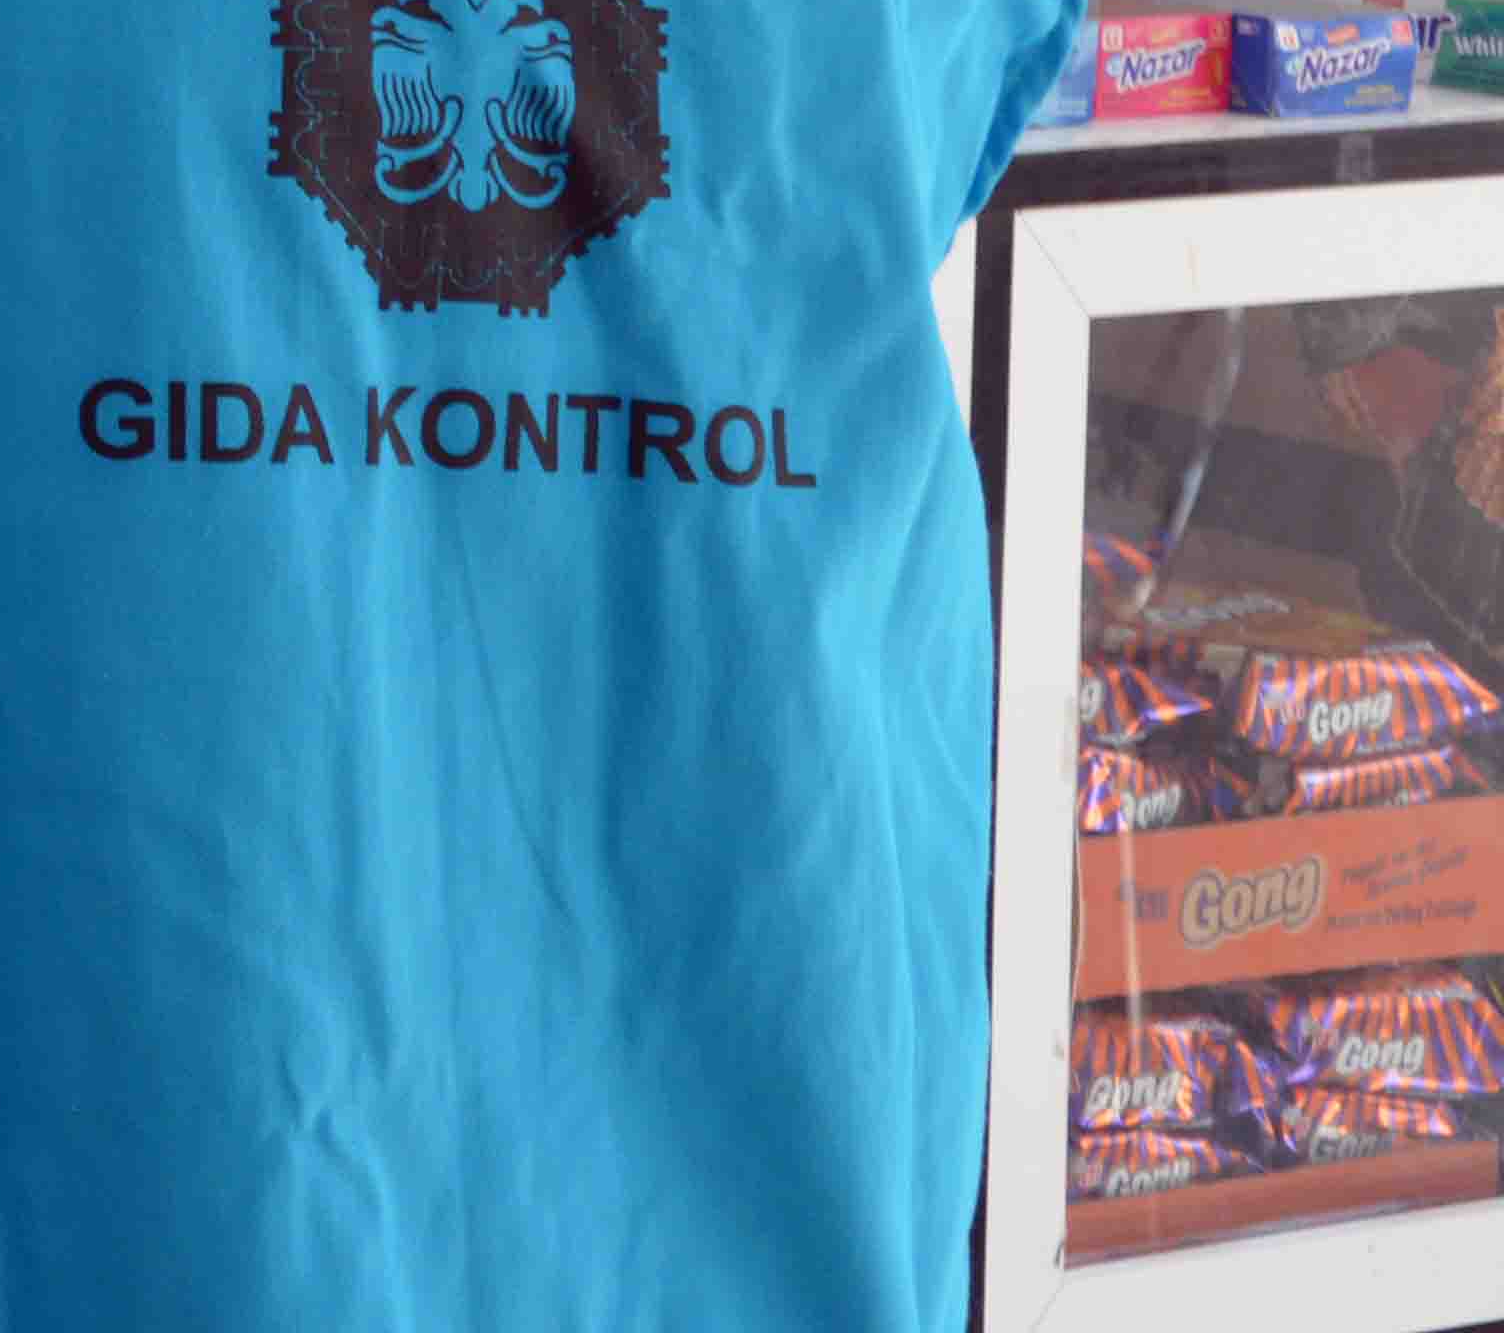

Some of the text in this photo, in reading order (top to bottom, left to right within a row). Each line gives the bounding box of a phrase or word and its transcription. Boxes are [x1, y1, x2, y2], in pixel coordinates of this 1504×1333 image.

[1118, 37, 1206, 93] Nazar
[1296, 37, 1390, 91] Nazar
[78, 376, 818, 489] GIDA KONTROL
[1308, 689, 1393, 745] Gong
[1183, 854, 1327, 949] Gong
[1336, 1033, 1425, 1077] Gong
